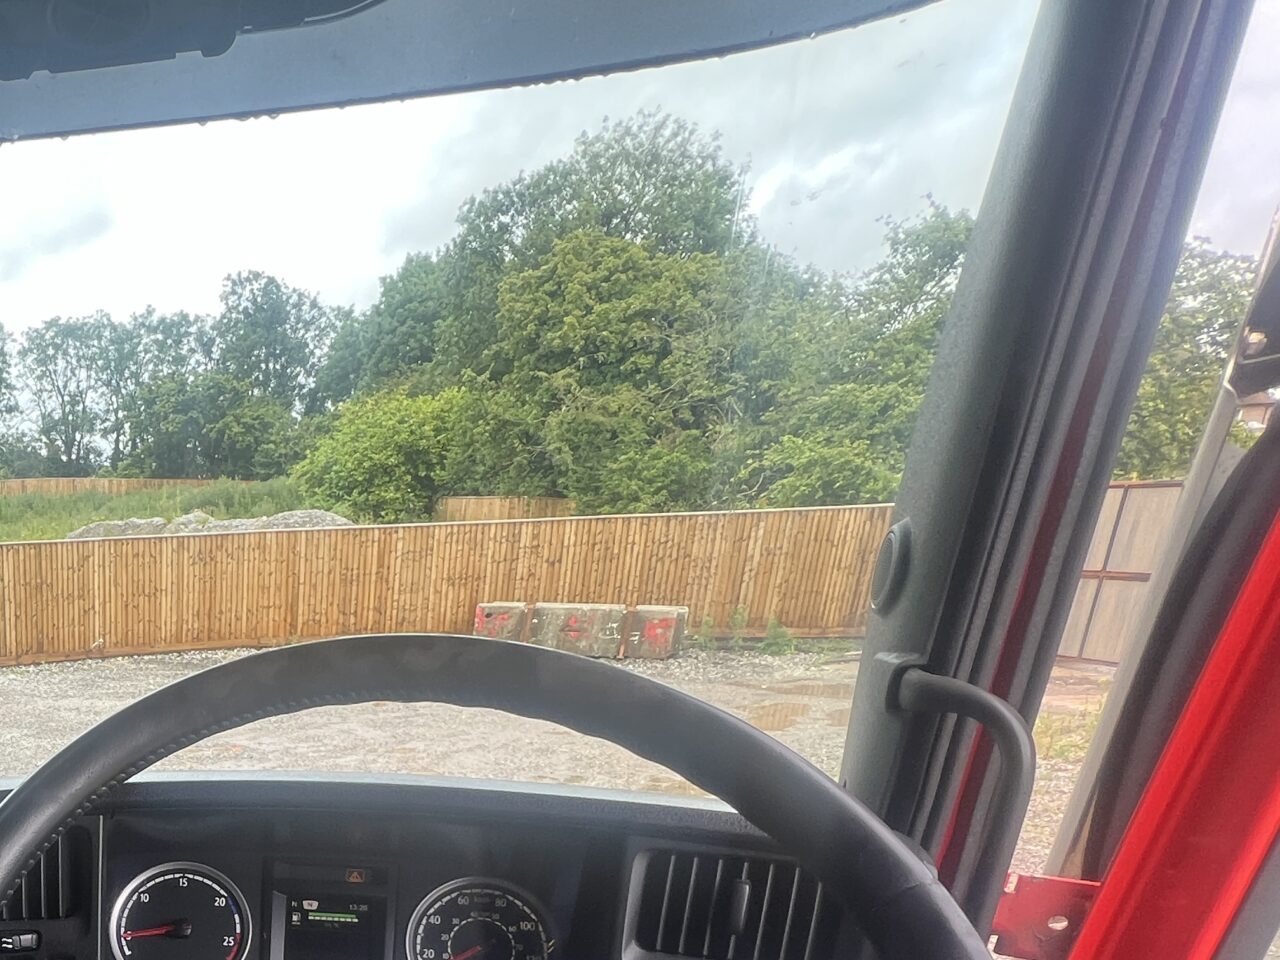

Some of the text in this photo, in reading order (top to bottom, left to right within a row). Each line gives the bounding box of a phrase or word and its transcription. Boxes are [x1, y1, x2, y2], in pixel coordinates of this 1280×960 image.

[179, 878, 188, 887] 15
[140, 893, 150, 903] 10
[214, 897, 226, 907] 20
[457, 896, 469, 905] 60
[428, 915, 441, 925] 40
[520, 921, 535, 931] 100
[222, 937, 235, 947] 25
[422, 949, 435, 959] 20
